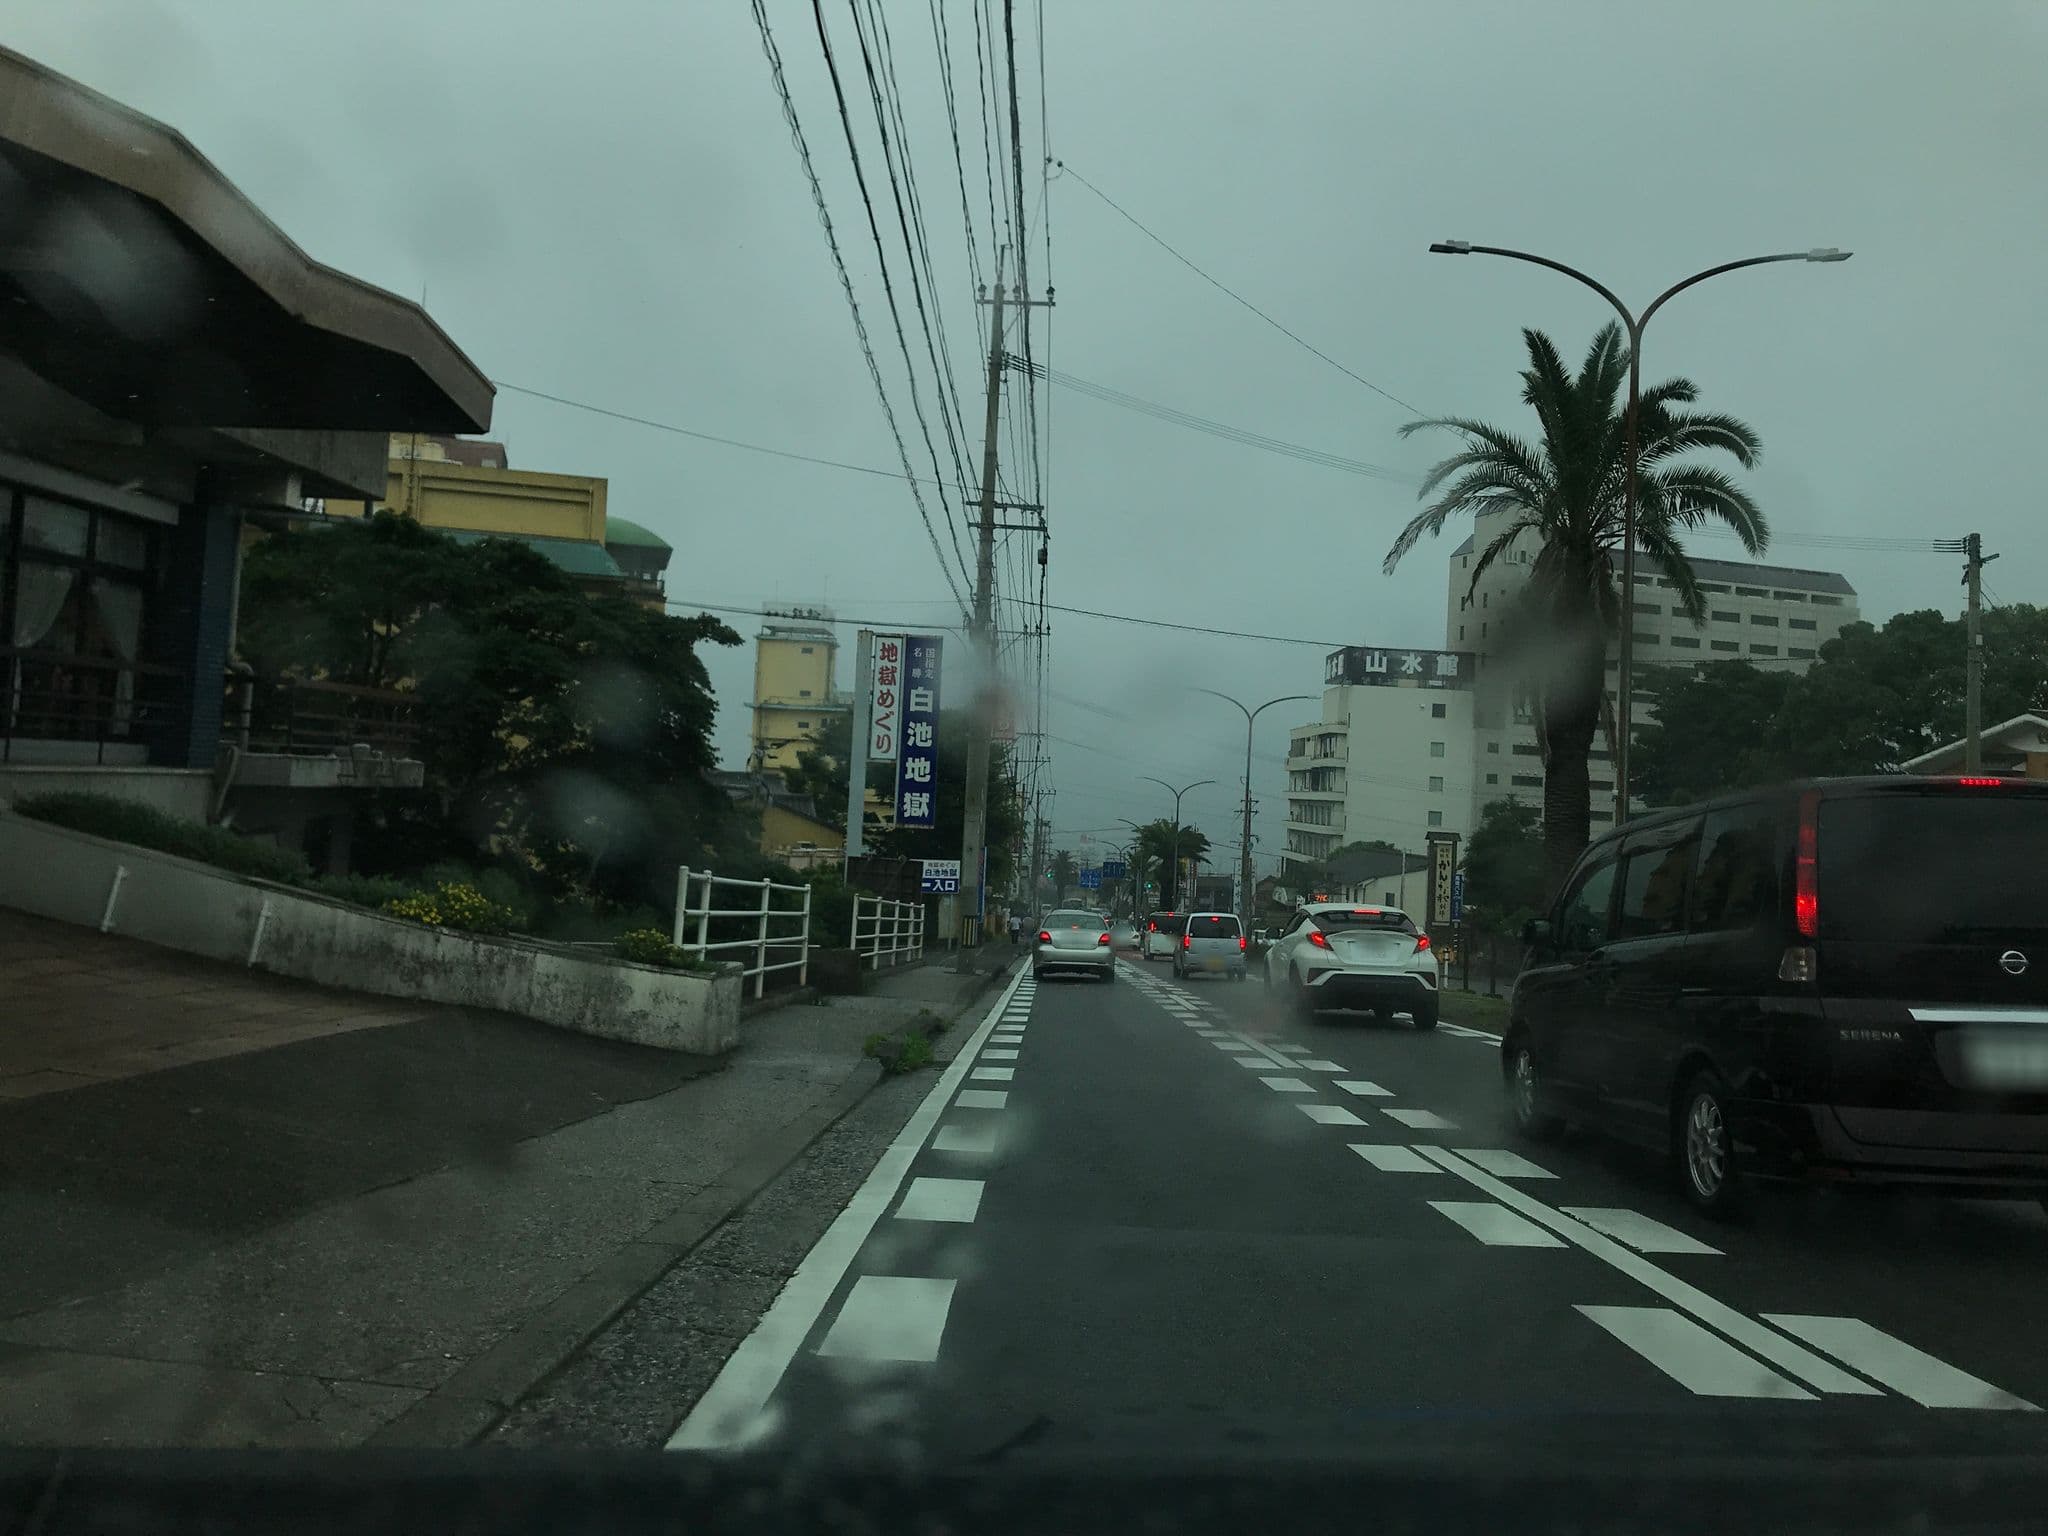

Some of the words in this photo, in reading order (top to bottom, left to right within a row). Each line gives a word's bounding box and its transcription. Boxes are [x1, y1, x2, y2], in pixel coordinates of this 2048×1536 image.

[1365, 650, 1459, 677] 山水館
[875, 642, 898, 754] 地獄めぐり
[903, 687, 934, 818] 白池地獄
[932, 879, 955, 892] 入口
[1839, 1029, 1904, 1041] SERENA
